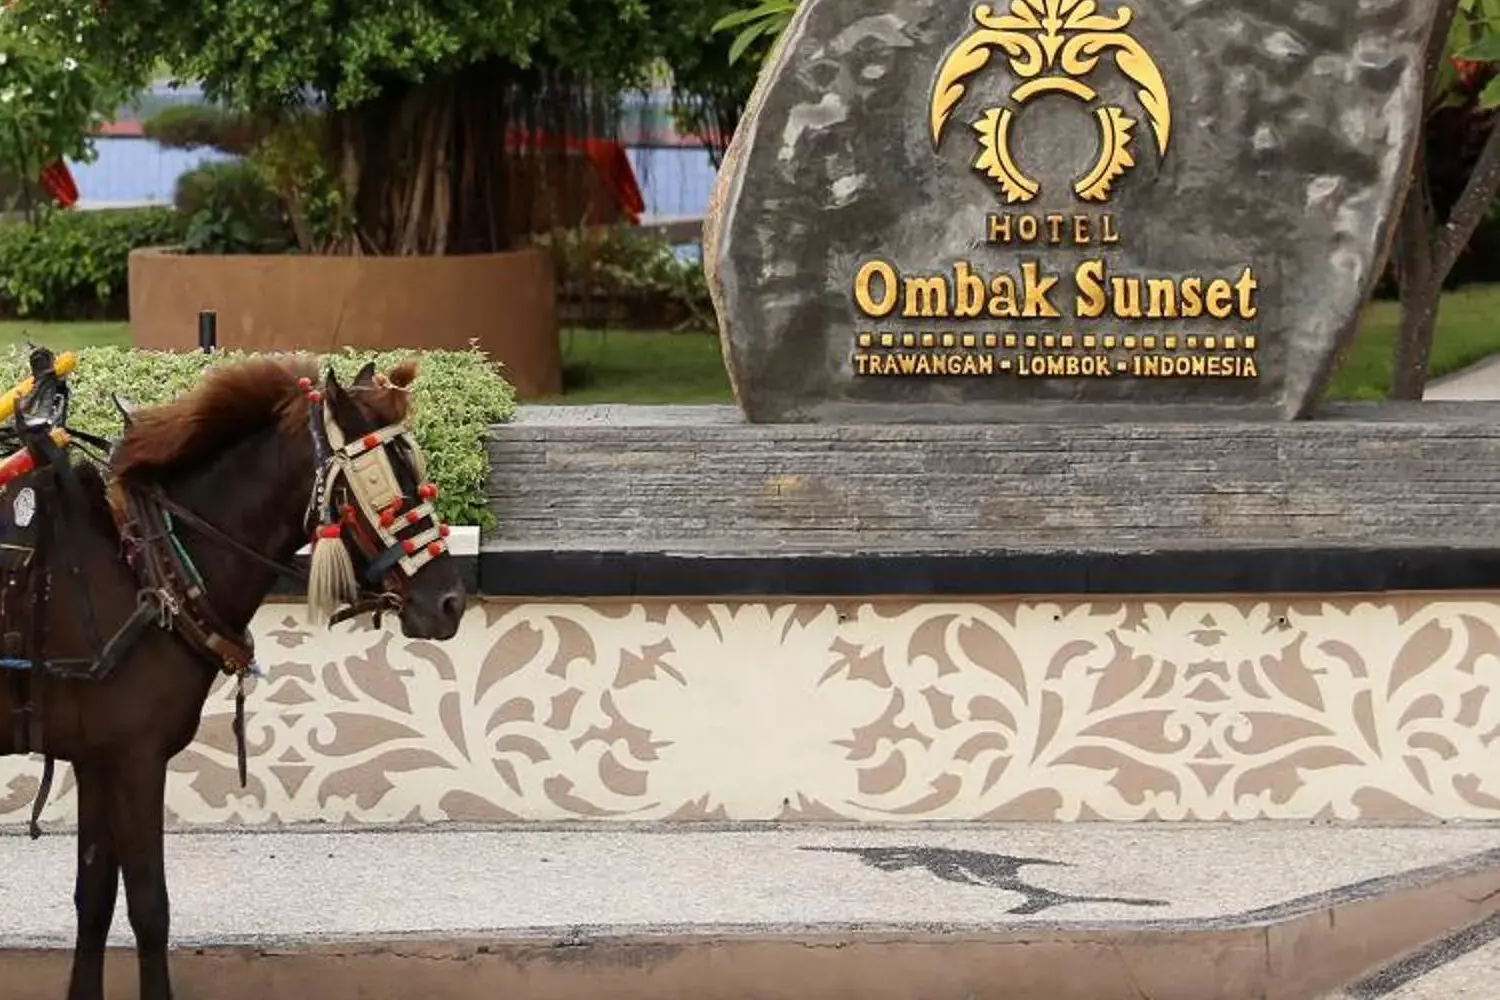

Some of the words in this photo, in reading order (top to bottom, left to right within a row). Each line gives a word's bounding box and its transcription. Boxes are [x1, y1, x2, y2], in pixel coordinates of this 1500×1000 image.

[988, 214, 1120, 244] HOTEL
[853, 259, 1061, 319] Ombak
[1074, 259, 1258, 319] Sunset
[855, 353, 994, 376] TRAWANGAN
[1018, 354, 1112, 376] LOMBOK
[1133, 355, 1258, 377] INDONESIA
